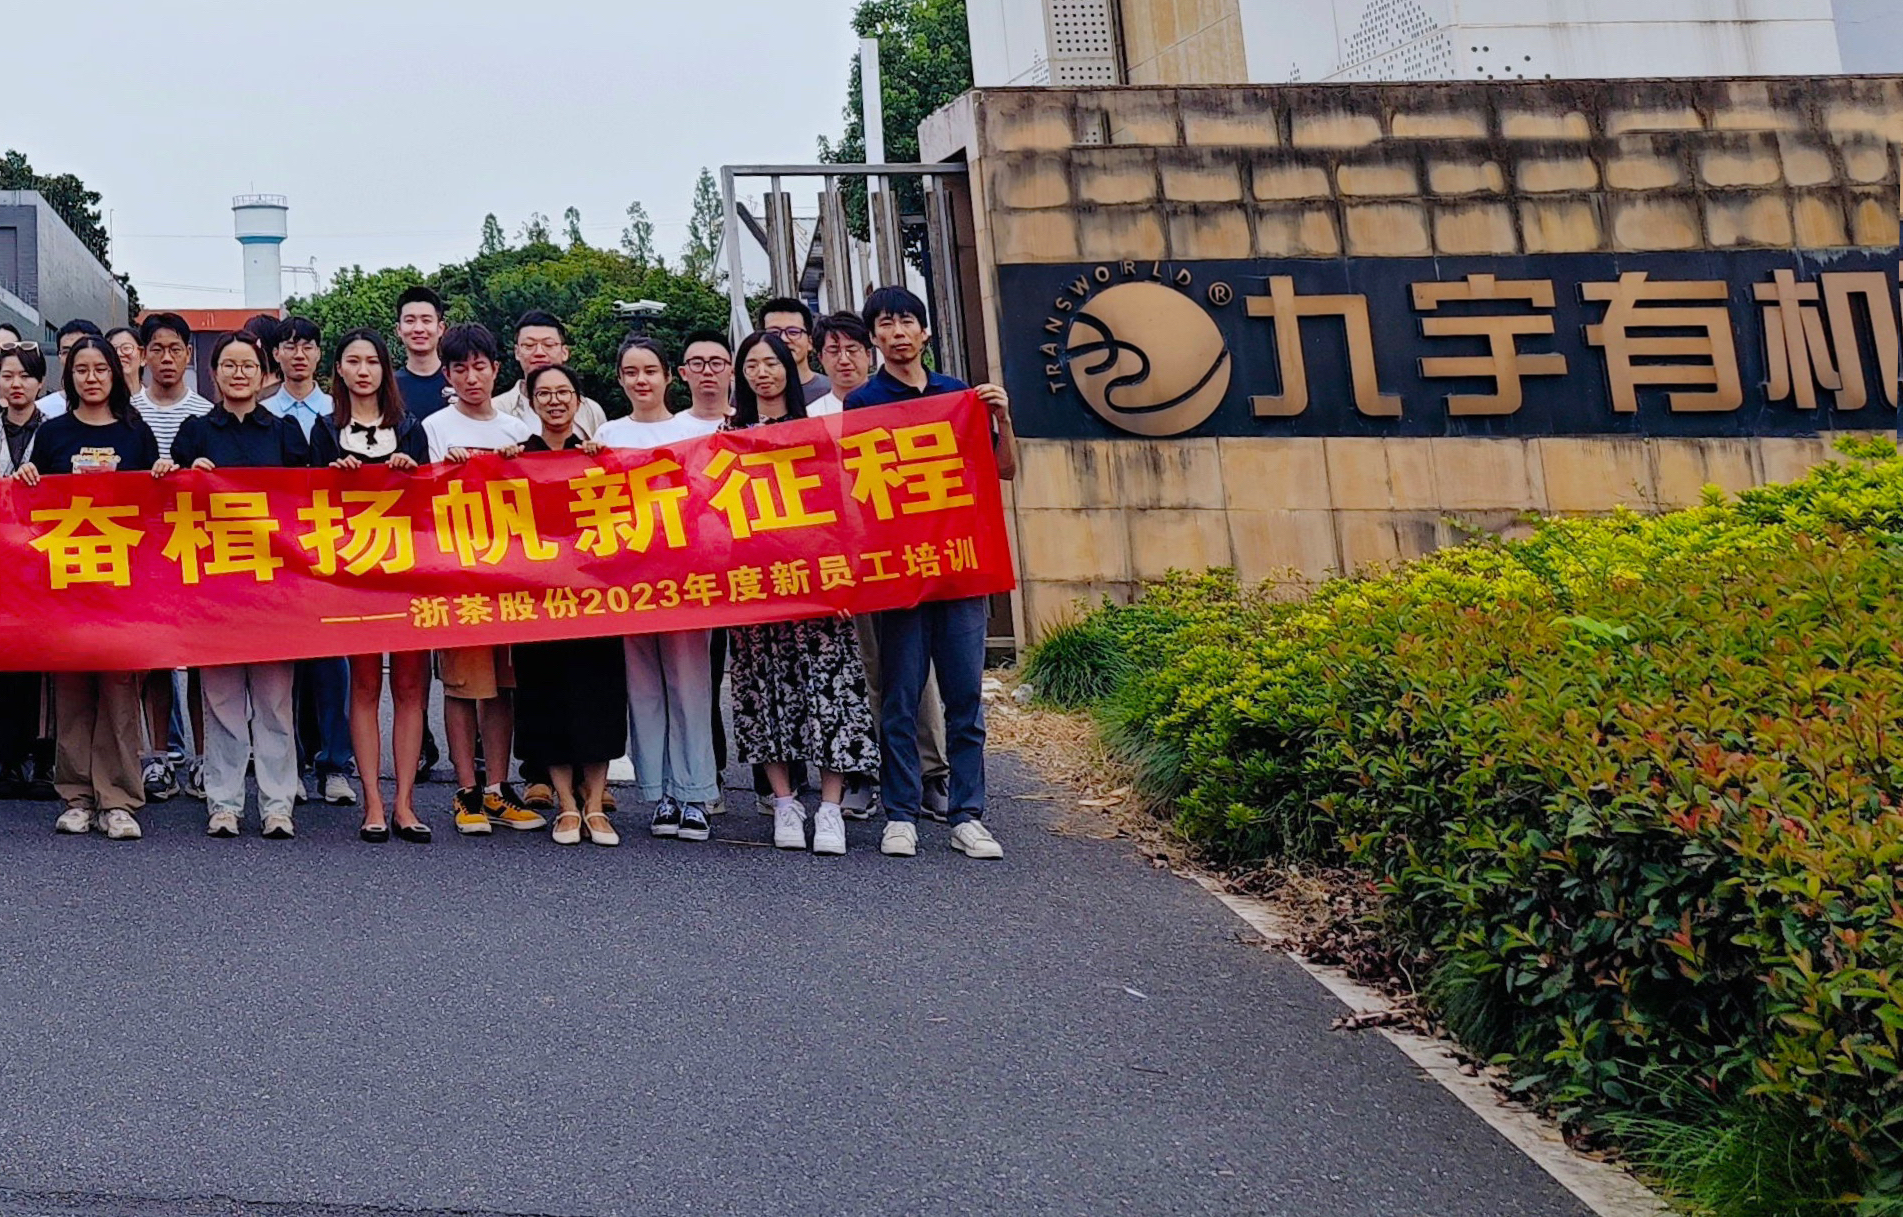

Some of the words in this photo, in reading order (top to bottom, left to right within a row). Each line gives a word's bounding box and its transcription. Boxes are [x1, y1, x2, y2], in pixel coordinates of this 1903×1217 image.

[1040, 260, 1193, 394] TRANSWORLD
[1245, 268, 1898, 412] 九宇有机
[29, 418, 974, 590] 奋楫扬帆新征程
